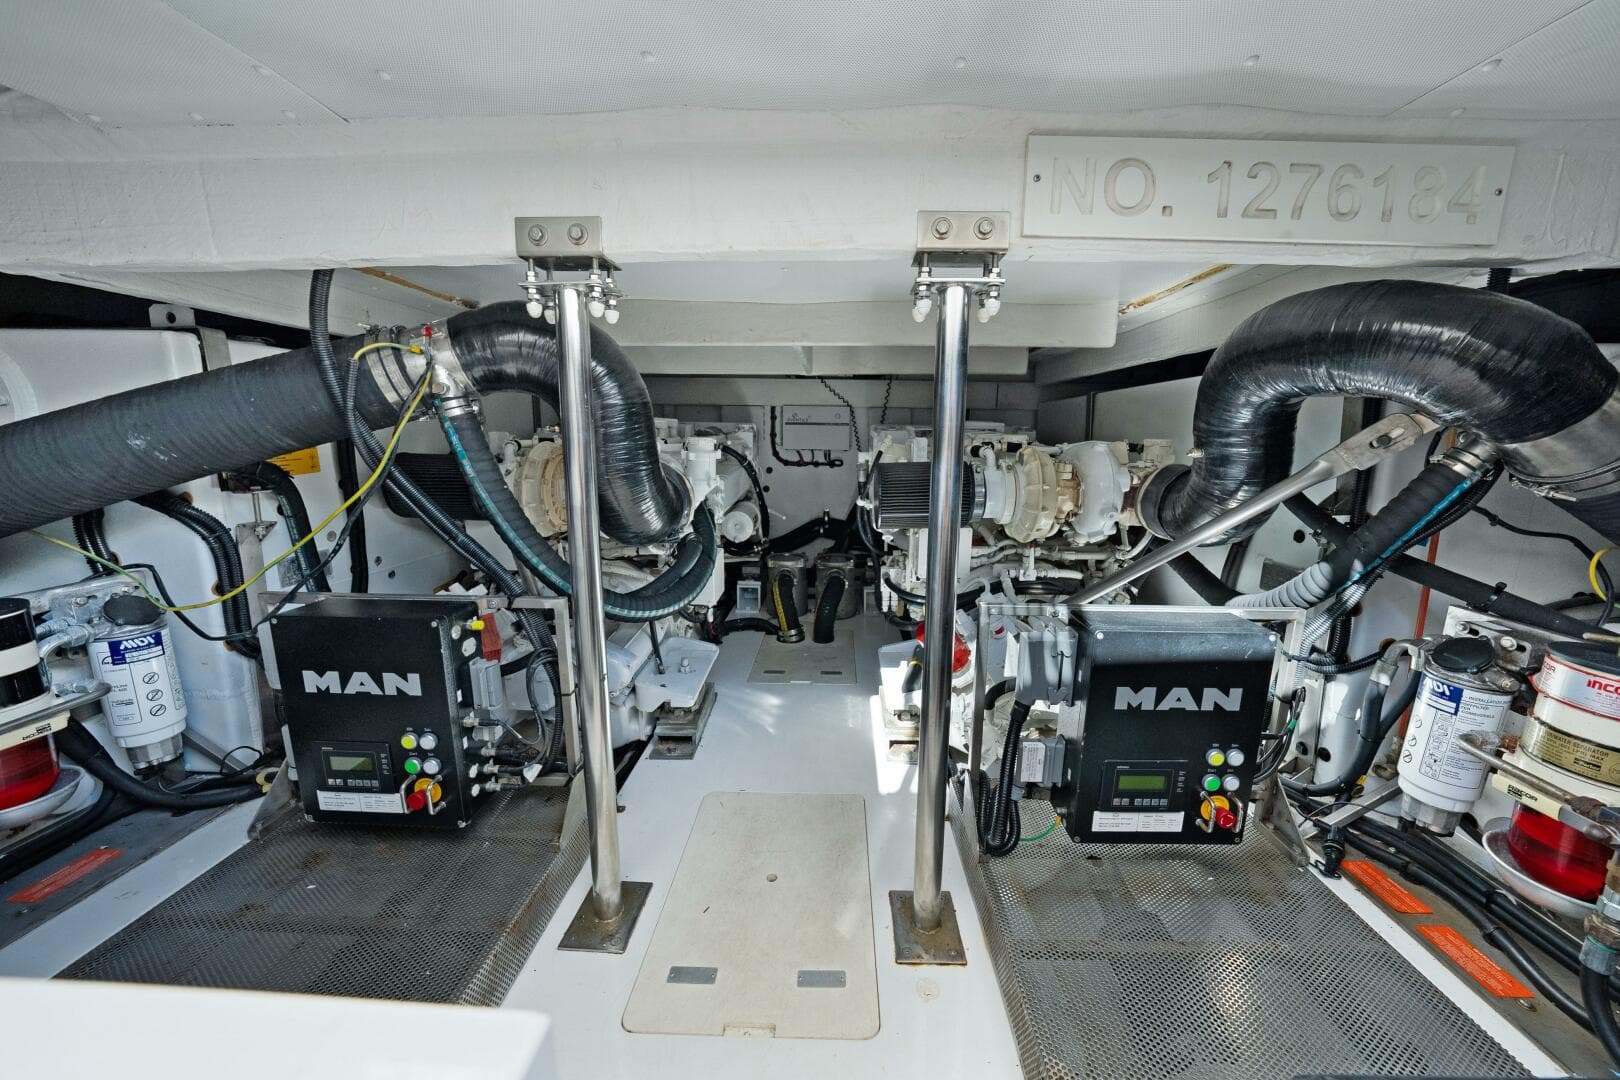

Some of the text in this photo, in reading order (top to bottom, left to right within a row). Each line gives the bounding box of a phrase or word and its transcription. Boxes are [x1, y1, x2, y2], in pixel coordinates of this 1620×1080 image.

[1050, 157, 1488, 226] NO. 1276184
[119, 635, 155, 650] MDI
[301, 669, 422, 697] MAN
[1114, 686, 1244, 712] MAN
